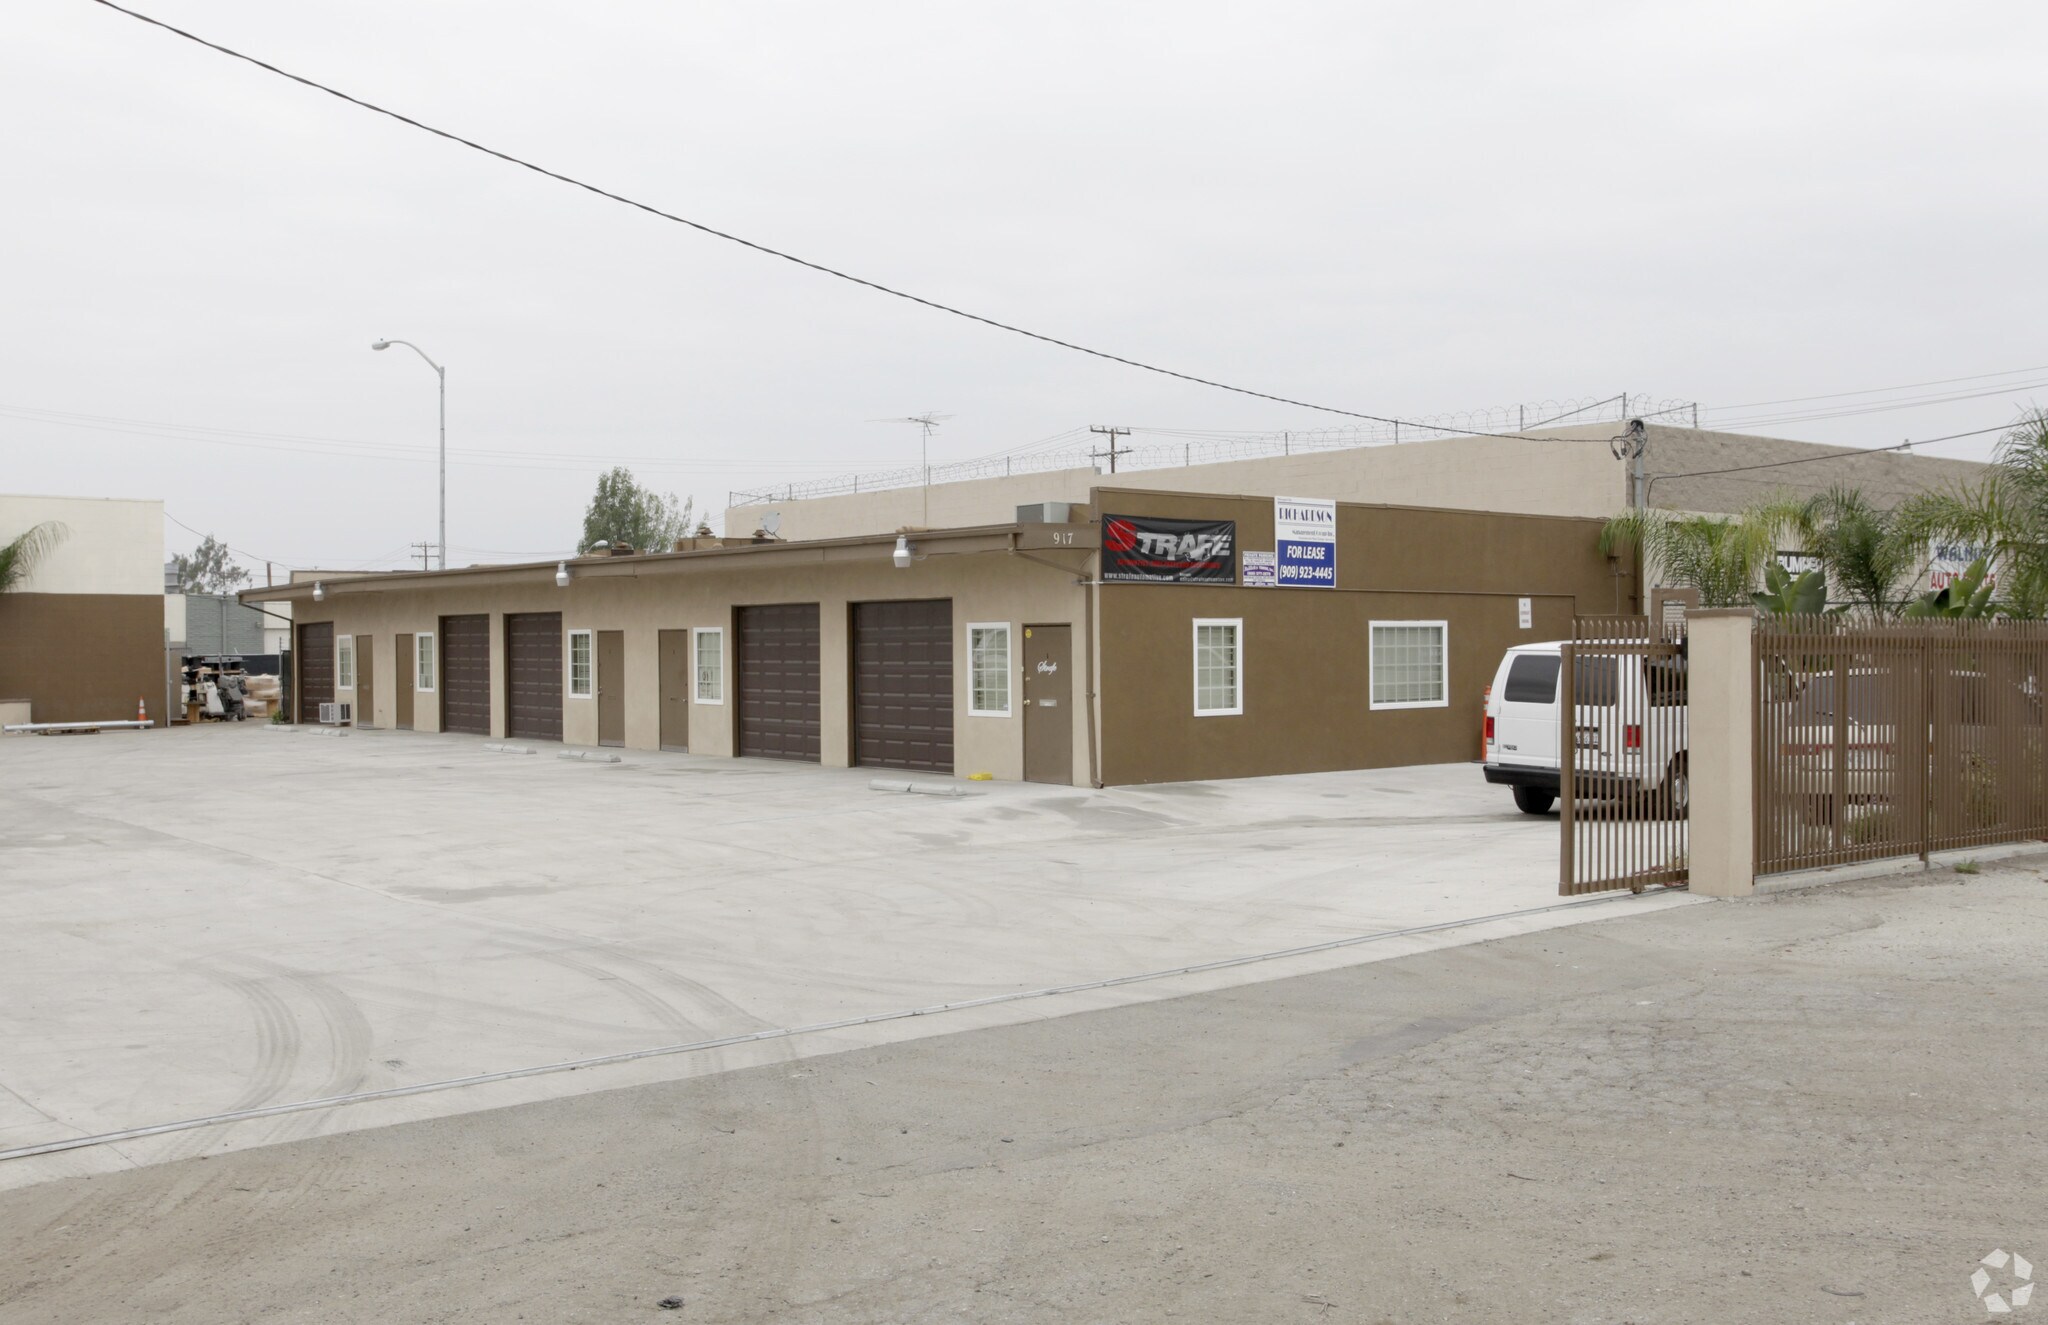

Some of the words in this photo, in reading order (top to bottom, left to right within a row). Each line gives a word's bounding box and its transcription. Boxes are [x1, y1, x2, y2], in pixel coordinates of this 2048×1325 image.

[1279, 507, 1332, 522] RICHARDSON
[1053, 532, 1073, 545] 917
[1287, 545, 1302, 559] FOR
[1303, 546, 1325, 560] LEASE
[1280, 565, 1298, 580] (909)
[1299, 566, 1333, 580] 923-4445
